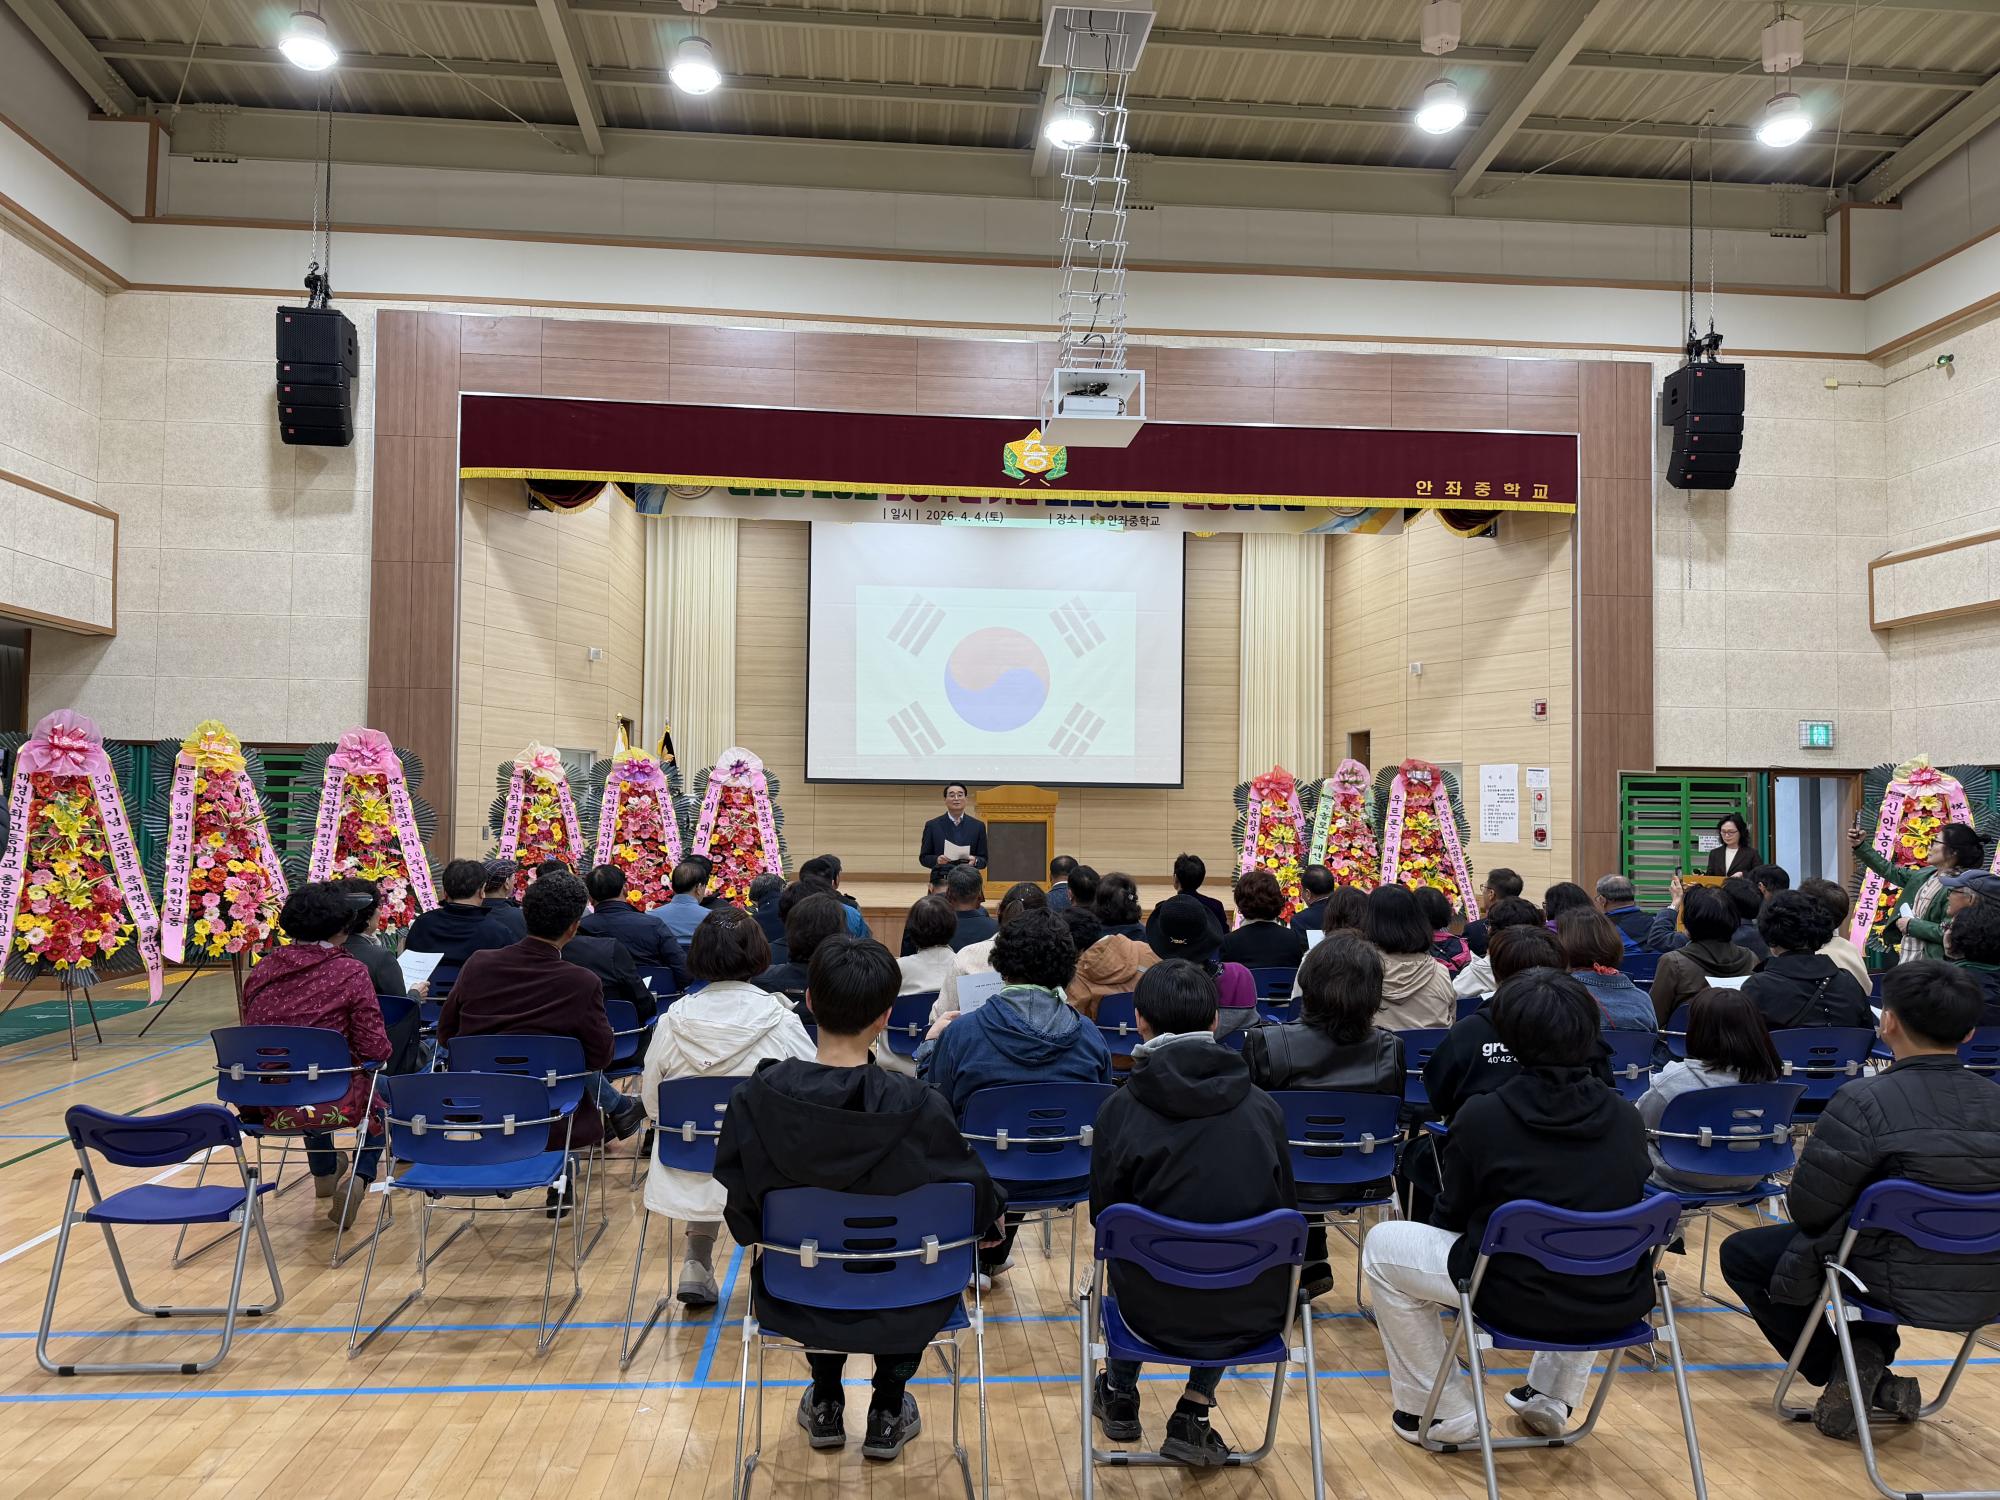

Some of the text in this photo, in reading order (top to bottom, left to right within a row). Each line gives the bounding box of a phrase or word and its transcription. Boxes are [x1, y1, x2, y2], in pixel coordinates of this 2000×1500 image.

[1415, 480, 1550, 500] 안좌중학교
[926, 510, 957, 522] 2026.
[1107, 514, 1160, 528] 안좌중학교
[391, 790, 413, 829] 안좌중학교
[504, 783, 522, 837] 안좌중학교
[704, 789, 719, 813] 28회
[757, 800, 772, 829] 안좌중학교
